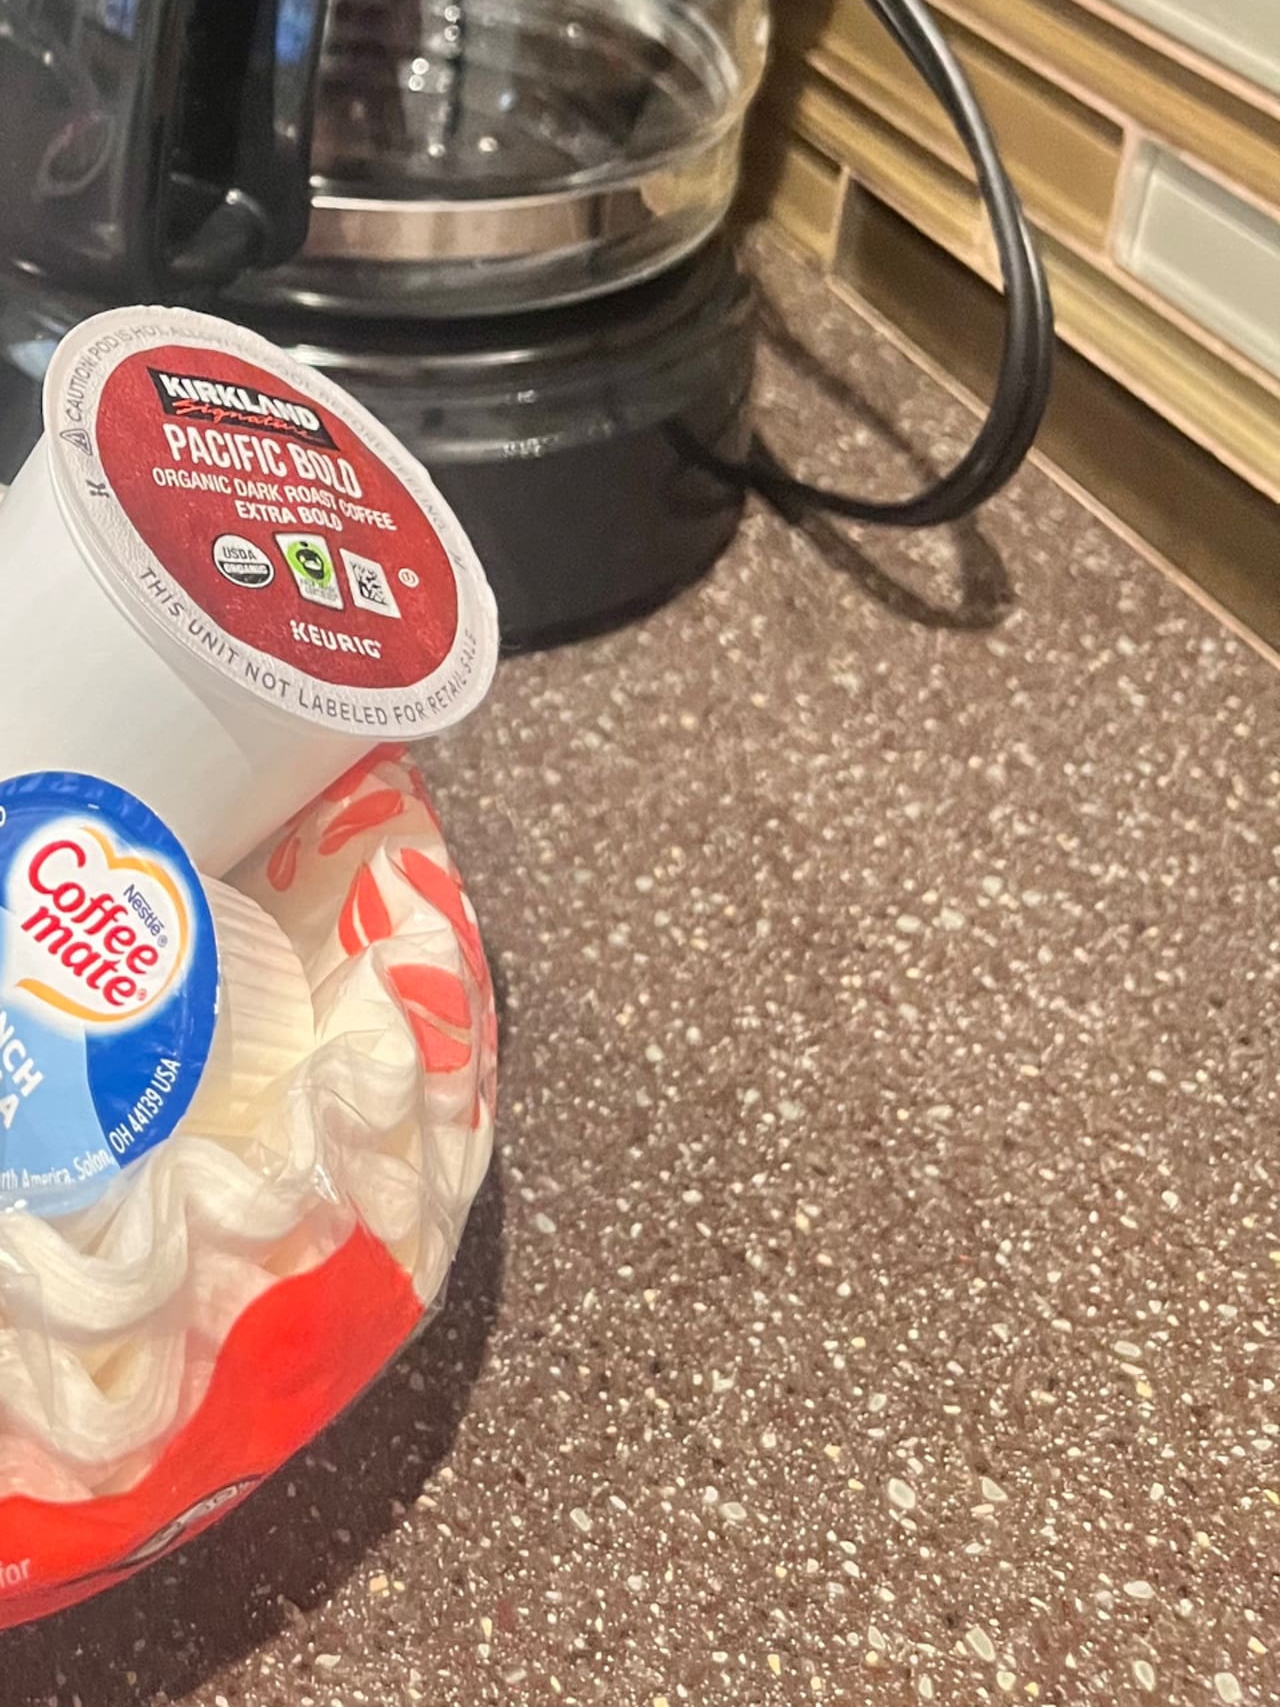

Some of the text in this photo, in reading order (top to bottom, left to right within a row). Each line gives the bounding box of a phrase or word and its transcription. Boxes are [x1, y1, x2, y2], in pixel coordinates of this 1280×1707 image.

[159, 374, 320, 431] KIRKLAND
[163, 423, 363, 499] PACIFIC BOLD
[152, 467, 397, 531] ORGANIC DARK ROAST COFFEE
[234, 500, 343, 531] EXTRA BOLD
[222, 546, 257, 561] USDA
[140, 568, 185, 617] THIS
[188, 618, 238, 666] UNIT
[245, 661, 291, 698] NOT
[299, 688, 388, 725] LABELED
[394, 704, 426, 725] FOR
[429, 674, 468, 713] RETAIL
[290, 620, 382, 660] KEURIG
[28, 840, 159, 975] Coffee
[20, 905, 138, 1006] mate
[109, 1123, 135, 1154] OH
[127, 1087, 165, 1134] 44139
[151, 1057, 182, 1094] USA
